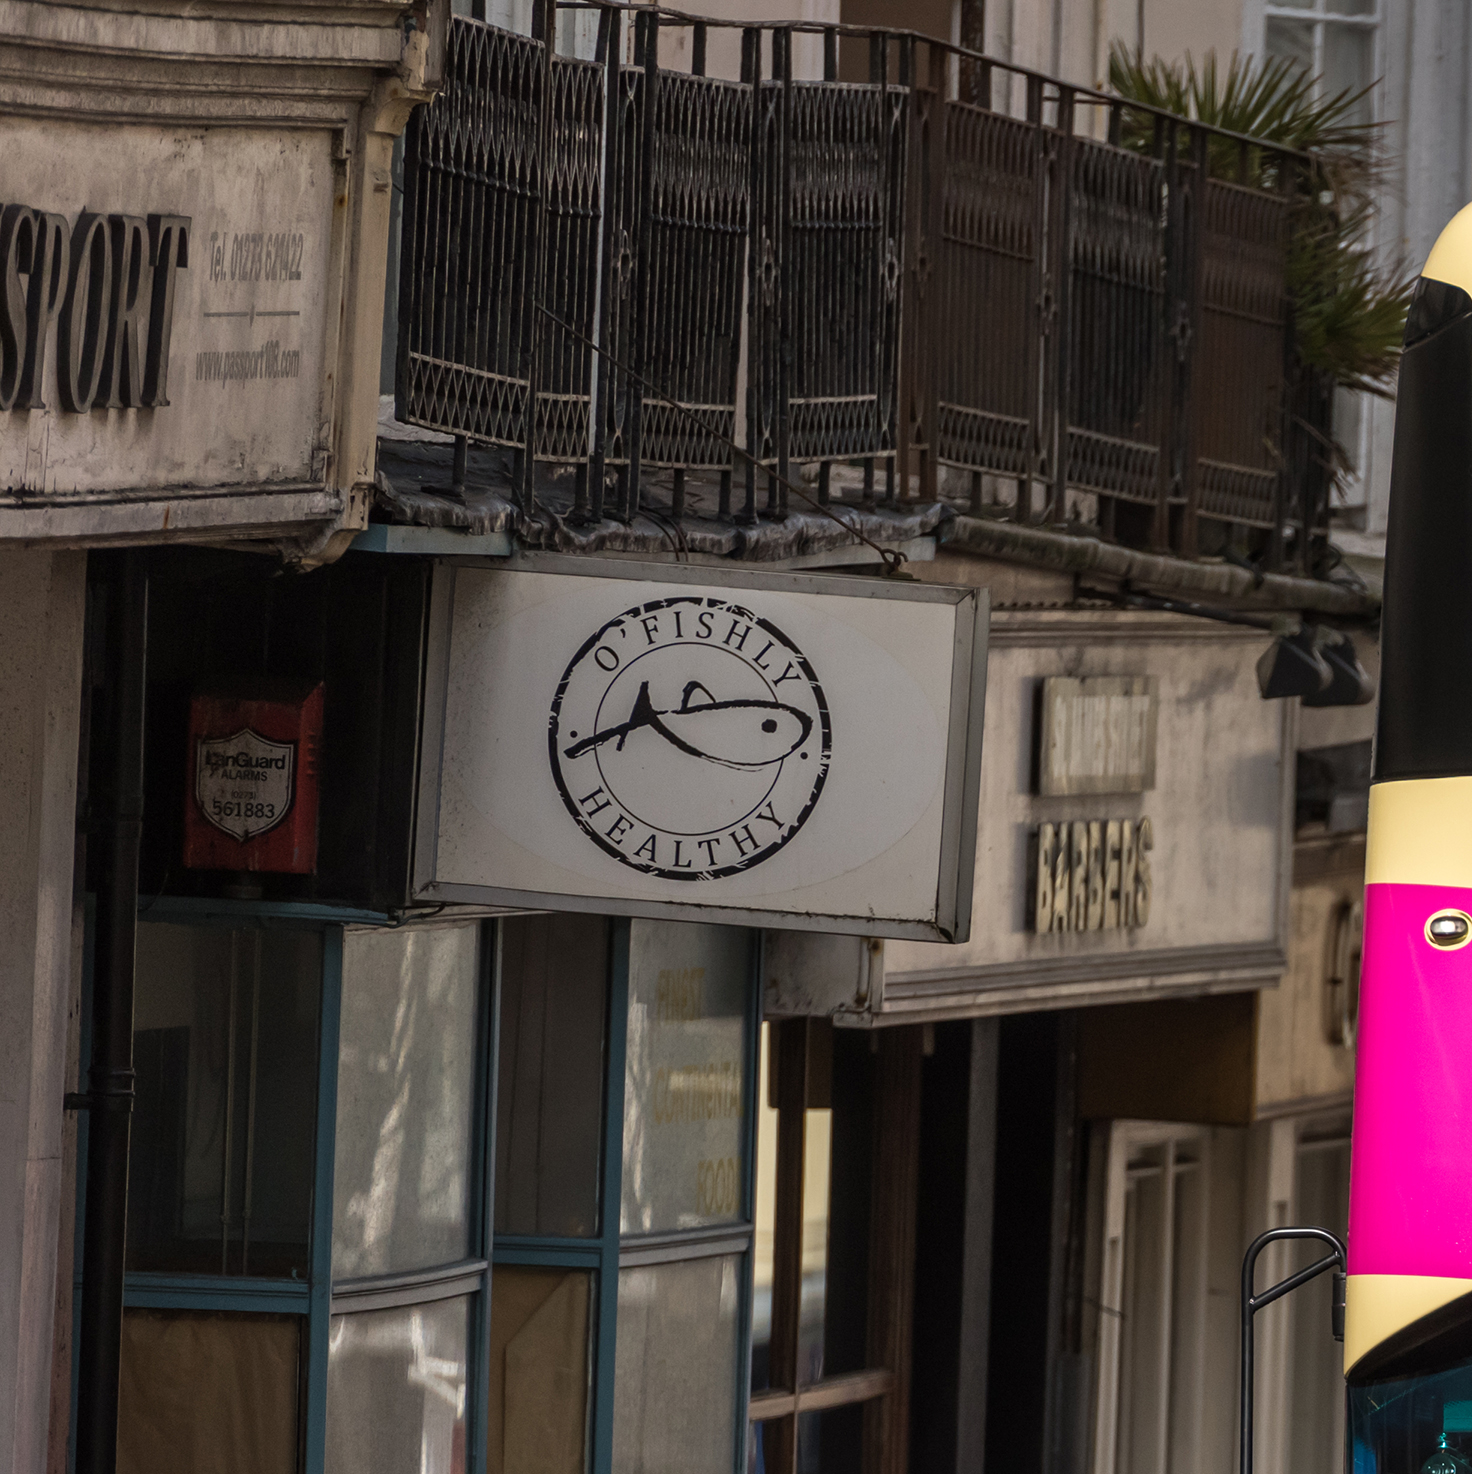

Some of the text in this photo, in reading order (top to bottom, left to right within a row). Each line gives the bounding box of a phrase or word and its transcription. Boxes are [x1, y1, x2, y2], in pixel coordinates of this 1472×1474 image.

[230, 231, 264, 281] 01273
[594, 610, 802, 687] O'FISHLY
[221, 769, 268, 782] ALARMS
[212, 800, 275, 819] 561883
[578, 786, 786, 868] HEALTHY
[1036, 815, 1153, 934] BARBERS
